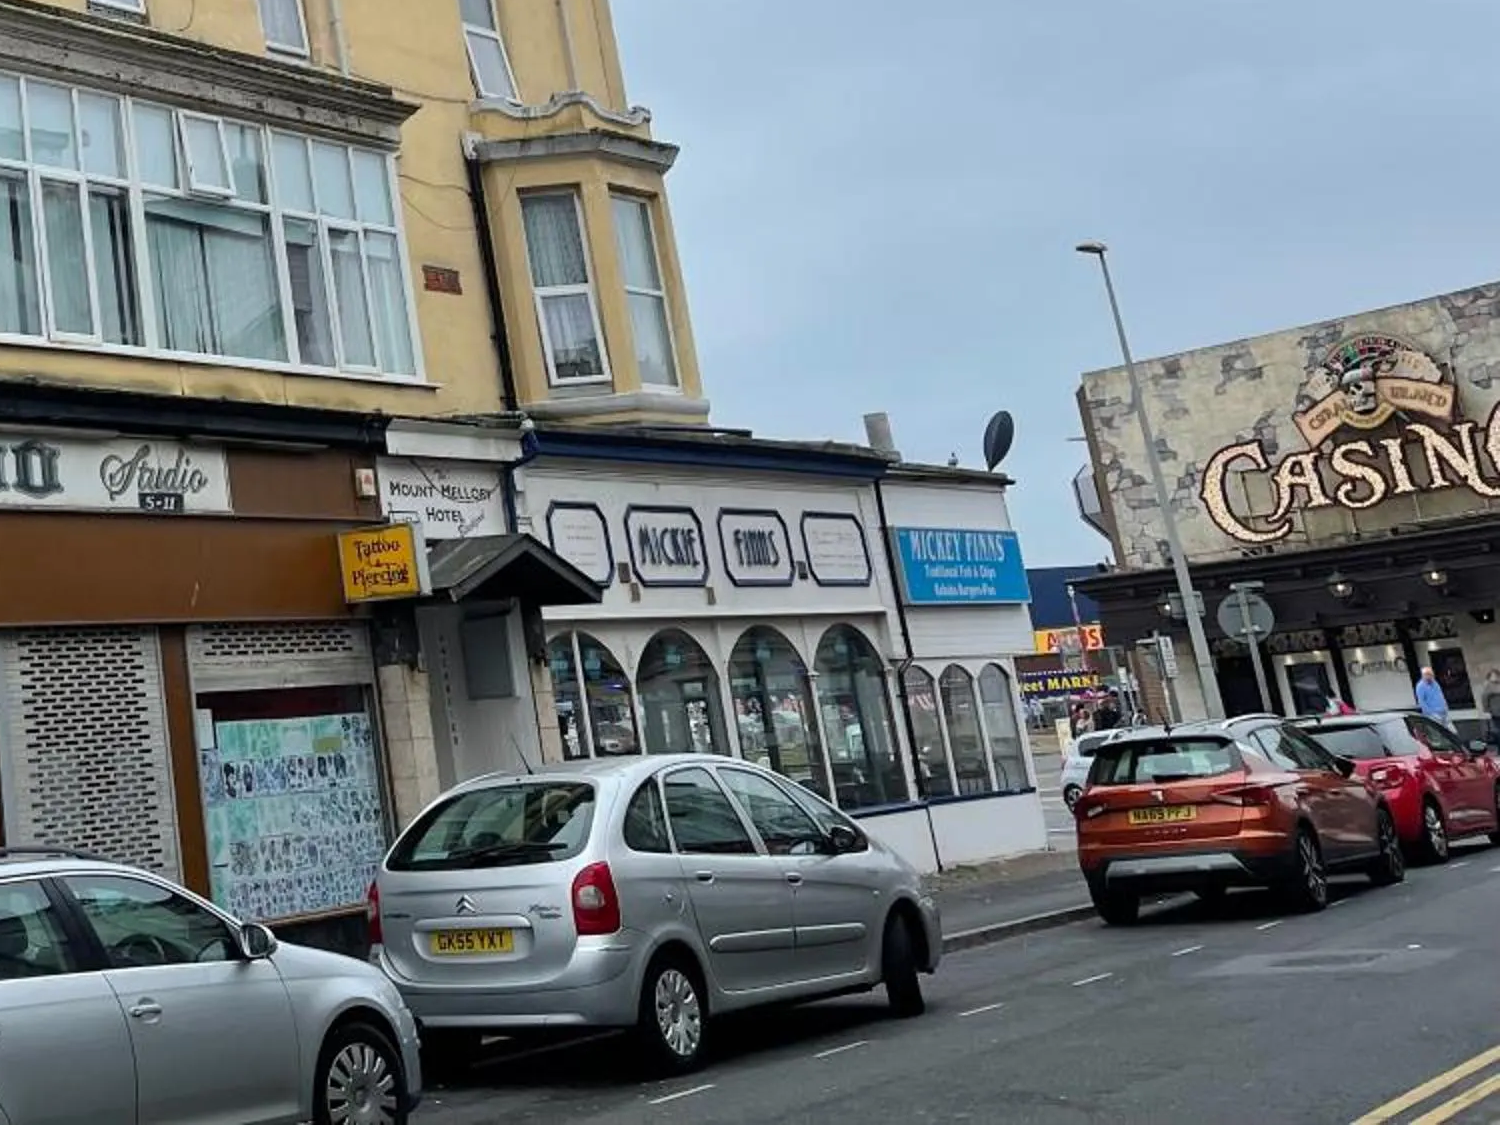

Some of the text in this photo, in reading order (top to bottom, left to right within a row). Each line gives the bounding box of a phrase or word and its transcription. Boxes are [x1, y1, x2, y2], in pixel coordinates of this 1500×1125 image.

[99, 444, 208, 501] Studio
[1201, 401, 1500, 543] CASIN
[389, 481, 434, 497] MOUNT
[425, 507, 465, 523] HOTEL
[910, 530, 1005, 562] MICKEY FINNS
[438, 931, 505, 951] GK55 YXT
